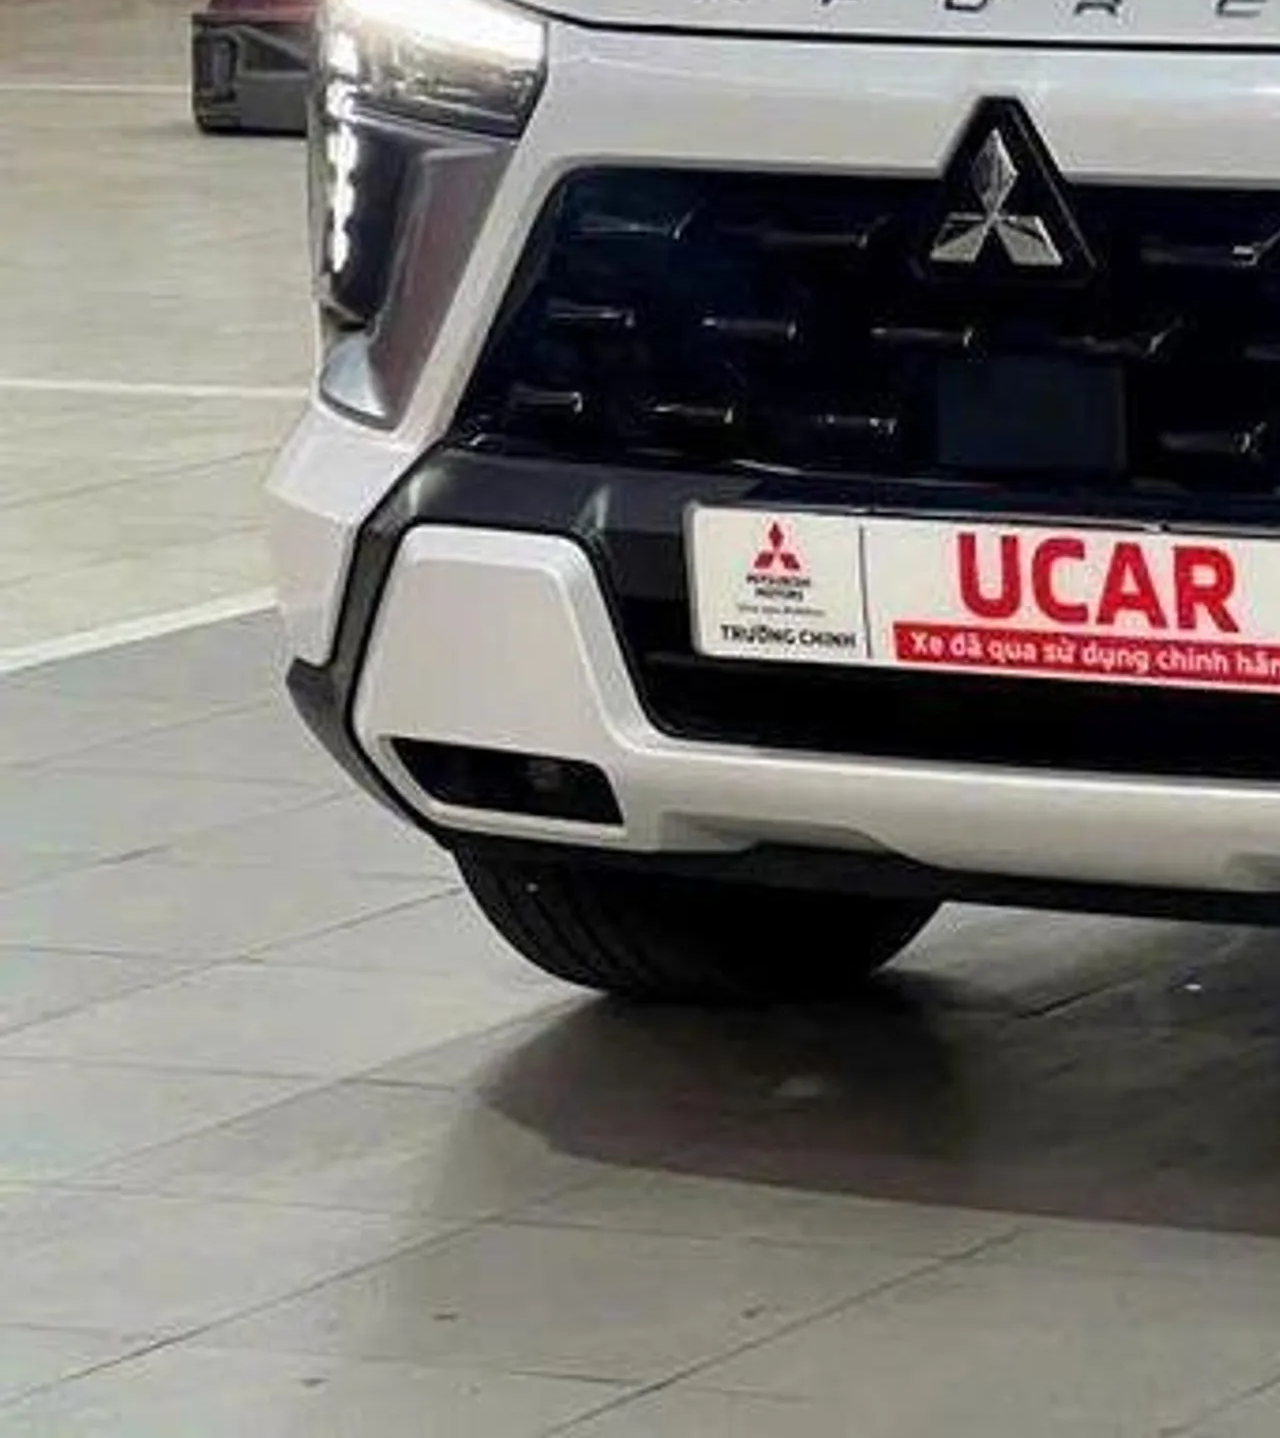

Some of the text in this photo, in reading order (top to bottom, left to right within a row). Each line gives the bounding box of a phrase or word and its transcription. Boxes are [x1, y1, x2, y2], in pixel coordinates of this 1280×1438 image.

[957, 532, 1240, 633] UCAR
[911, 630, 945, 657] Xe
[987, 639, 1038, 665] qua
[1081, 638, 1151, 674] dụng
